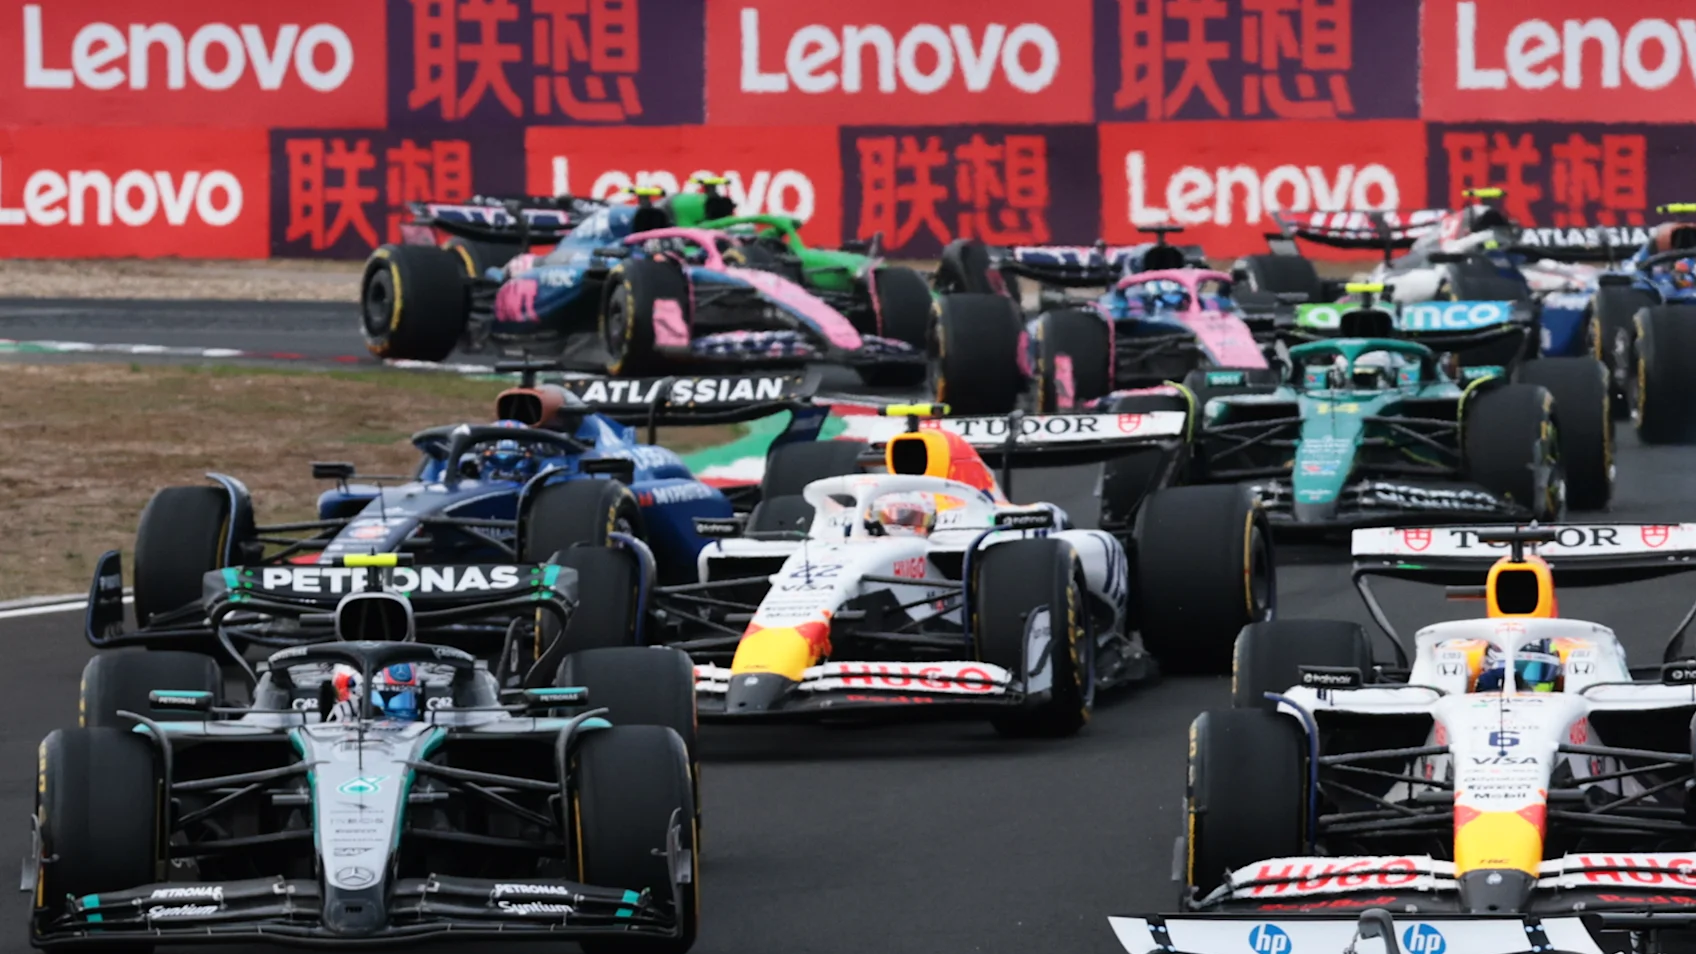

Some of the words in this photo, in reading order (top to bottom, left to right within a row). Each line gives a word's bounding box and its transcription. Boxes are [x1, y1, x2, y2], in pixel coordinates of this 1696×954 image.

[23, 3, 354, 92] Lenovo
[408, 0, 644, 122] 联想
[740, 8, 1060, 94] Lenovo
[1114, 0, 1355, 120] 联想
[856, 134, 1049, 247] 联想
[1127, 151, 1399, 226] Lenovo
[1444, 132, 1647, 227] 联想
[285, 138, 473, 252] 联想
[1521, 227, 1656, 246] ATLASSIA
[1308, 304, 1499, 330] amco
[955, 416, 1099, 436] TUDOR
[1450, 527, 1621, 549] TOR
[839, 664, 994, 692] HUGO
[1488, 731, 1521, 747] 6
[1472, 757, 1539, 765] VISA
[495, 883, 569, 897] PETRONAS
[1250, 858, 1418, 896] HUGO
[150, 886, 224, 901] PETRONAS
[148, 903, 219, 919] Syntium
[497, 900, 574, 916] Syntium
